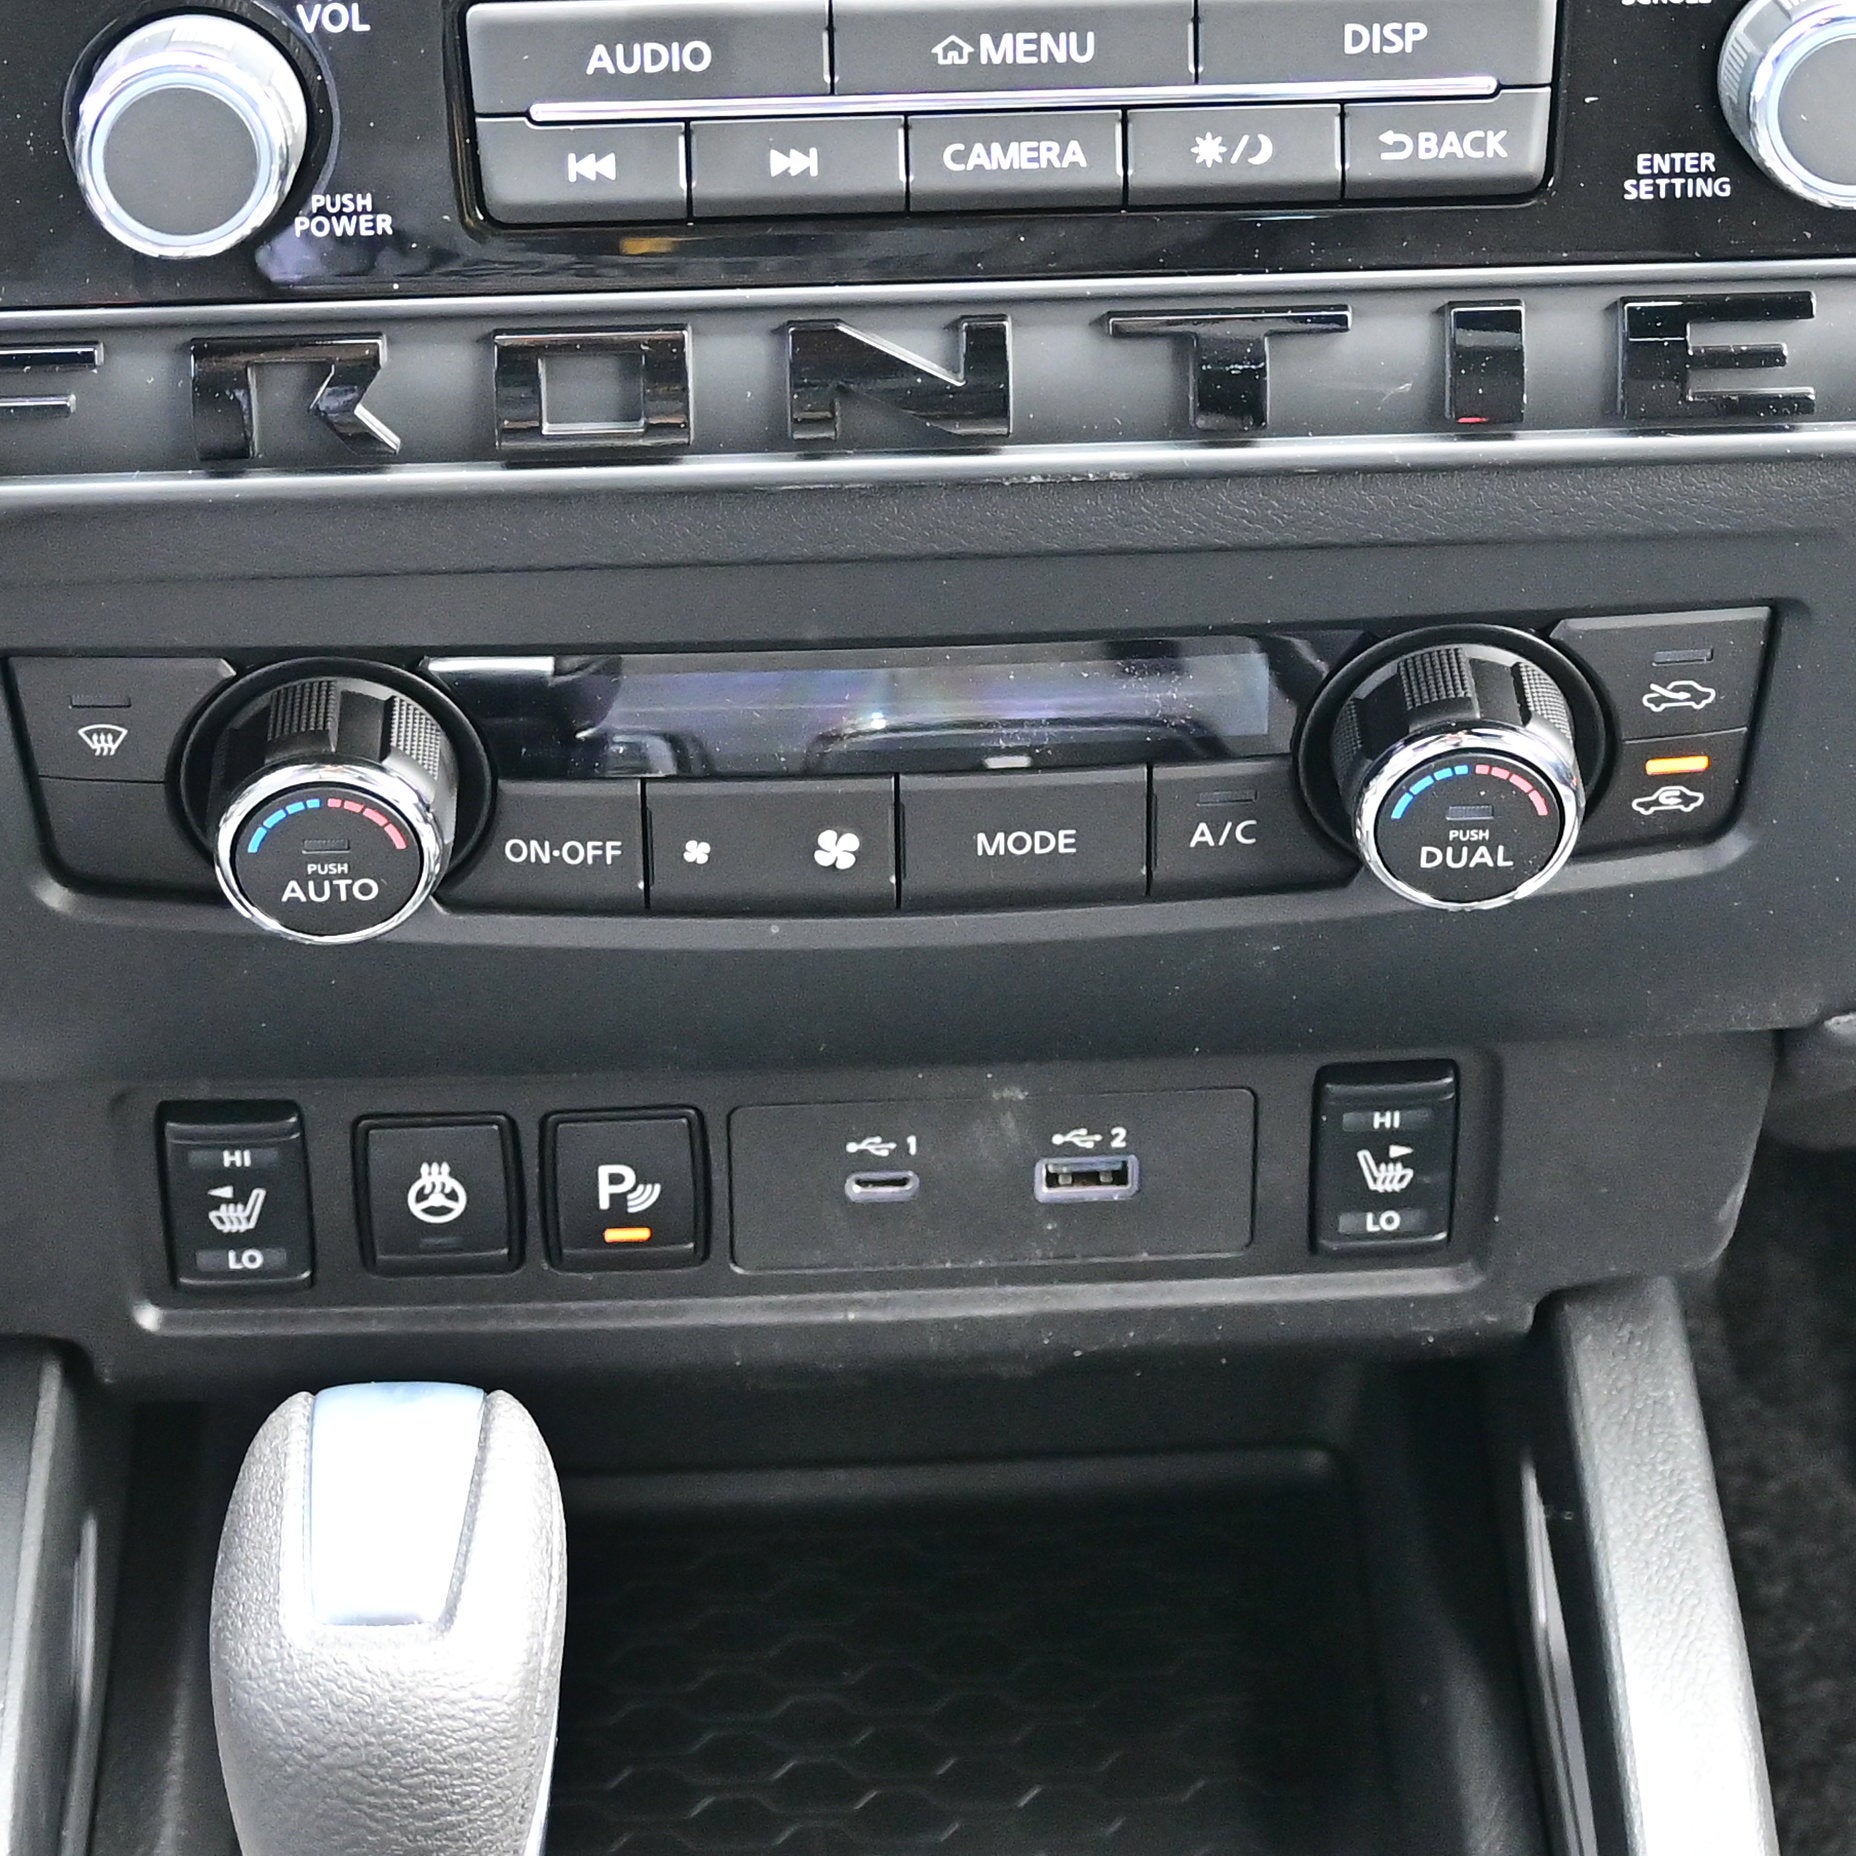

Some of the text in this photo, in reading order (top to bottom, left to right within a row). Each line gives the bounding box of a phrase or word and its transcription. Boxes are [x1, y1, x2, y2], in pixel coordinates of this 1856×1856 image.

[295, 2, 372, 34] VOL
[979, 31, 1096, 65] MENU
[1343, 21, 1428, 56] DISP
[585, 40, 712, 76] AUDIO
[942, 139, 1088, 174] CAMERA
[1417, 130, 1508, 160] BACK
[1635, 152, 1715, 175] ENTER
[1623, 176, 1731, 201] SETTING
[310, 193, 373, 215] PUSH
[293, 213, 394, 239] POWER
[977, 829, 1077, 857] MODE
[1189, 820, 1257, 848] A/C
[1449, 829, 1490, 842] PUSH
[307, 862, 348, 875] PUSH
[1419, 845, 1514, 870] DUAL
[281, 877, 379, 904] AUTO
[1372, 1110, 1401, 1130] HI
[906, 1136, 917, 1156] 1
[1110, 1127, 1127, 1148] 2
[223, 1150, 251, 1168] HI
[1365, 1210, 1401, 1232] LO
[228, 1249, 263, 1270] LO
